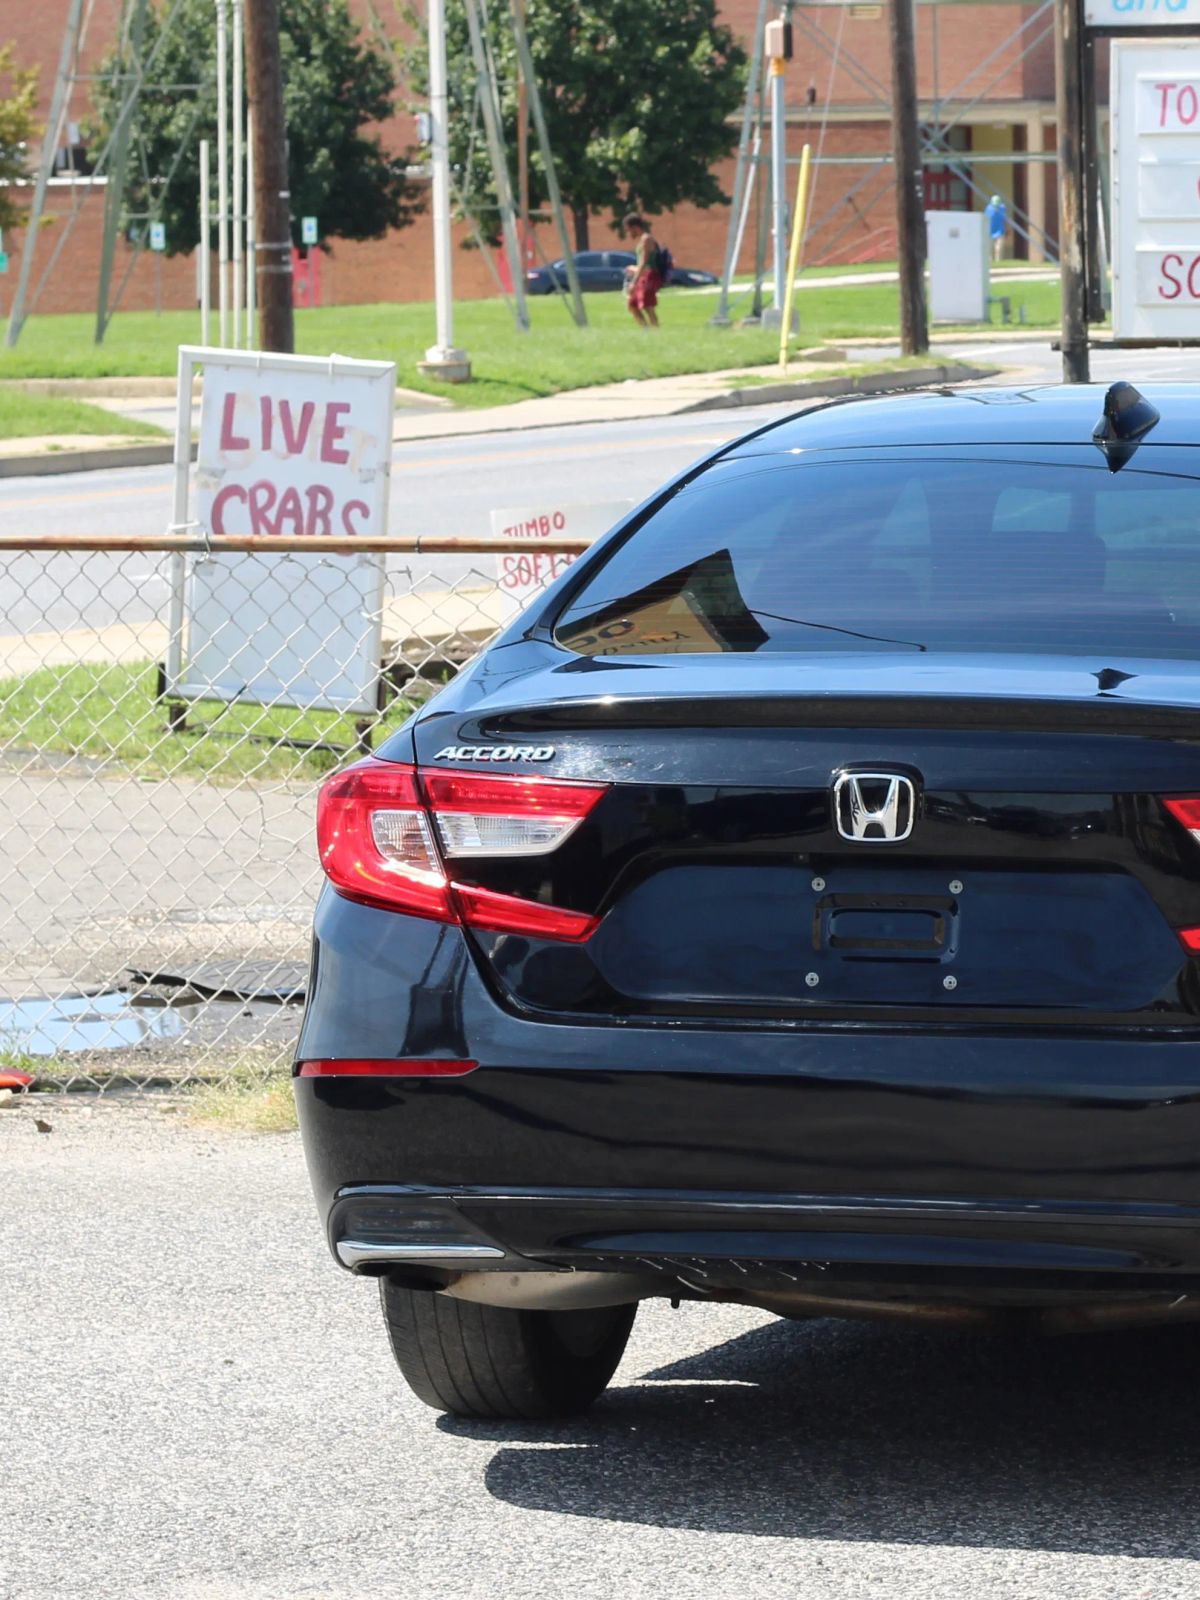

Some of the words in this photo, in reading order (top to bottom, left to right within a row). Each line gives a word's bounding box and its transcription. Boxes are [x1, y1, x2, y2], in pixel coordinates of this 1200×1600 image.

[219, 392, 352, 465] LIVE
[210, 479, 371, 556] CRABS
[433, 745, 557, 762] ACCORD
